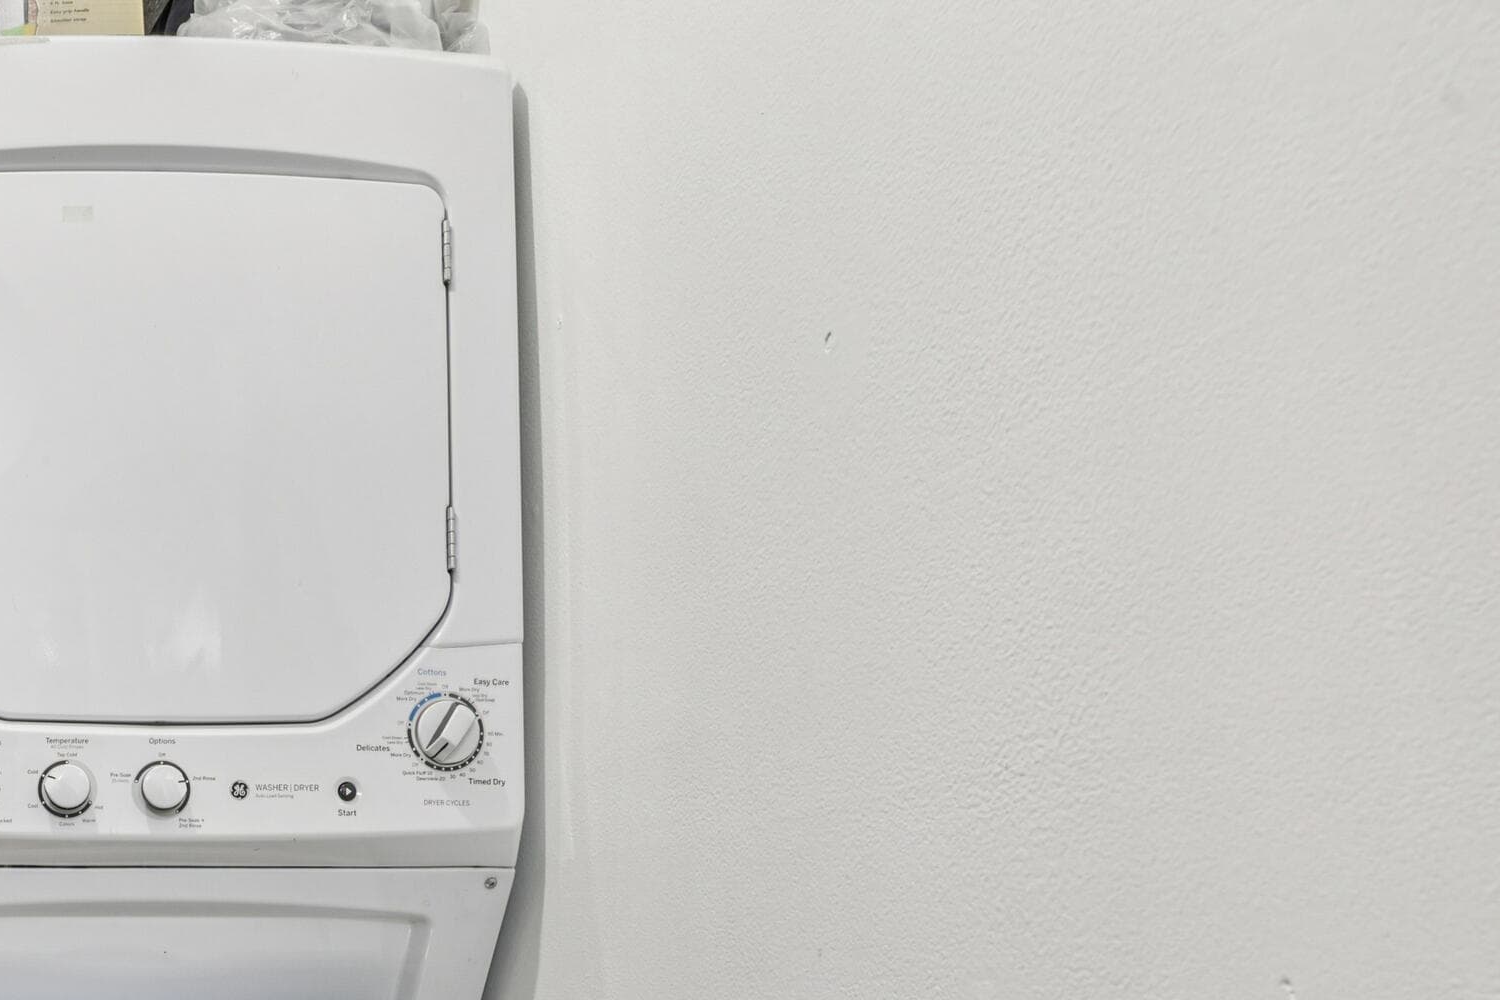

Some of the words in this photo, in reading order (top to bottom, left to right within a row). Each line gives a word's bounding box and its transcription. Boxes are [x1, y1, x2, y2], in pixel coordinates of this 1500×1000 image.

[417, 668, 446, 676] Cottons
[473, 678, 491, 688] Easy
[492, 678, 510, 686] Care
[46, 737, 89, 745] Temperature
[148, 737, 176, 745] Options
[356, 744, 390, 752] Delicates
[468, 777, 492, 785] Timed
[493, 778, 506, 787] Dry
[255, 784, 288, 792] WASHER
[293, 784, 320, 792] DRYER
[423, 799, 445, 807] DRYER
[446, 799, 470, 807] CYCLES
[337, 809, 357, 817] Start
